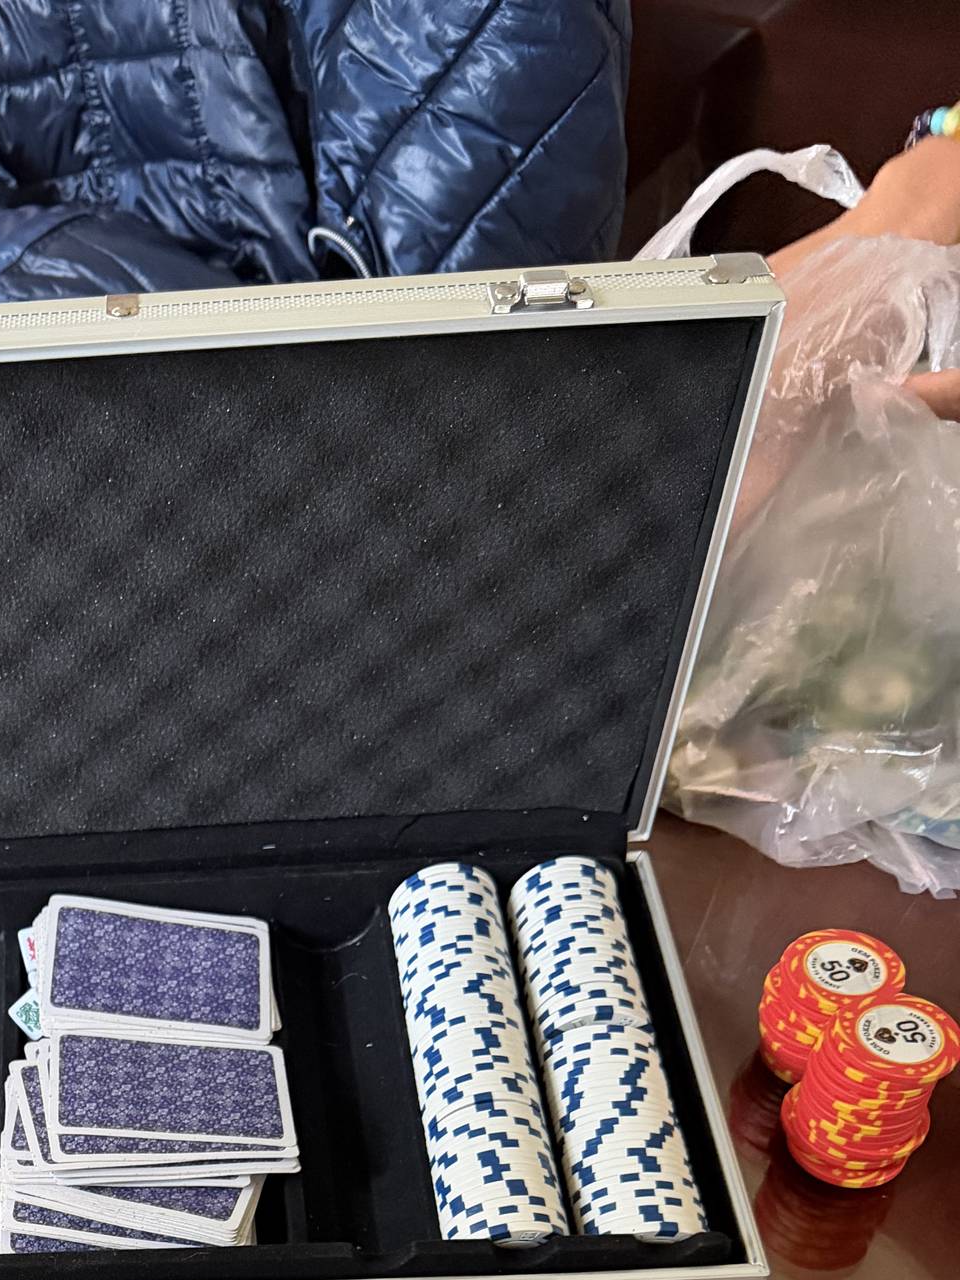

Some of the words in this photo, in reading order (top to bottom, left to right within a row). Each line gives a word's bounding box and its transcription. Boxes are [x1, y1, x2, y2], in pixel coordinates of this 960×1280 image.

[851, 947, 872, 959] GEM
[820, 960, 851, 982] 50
[862, 1019, 873, 1041] POKER
[896, 1020, 927, 1043] 50
